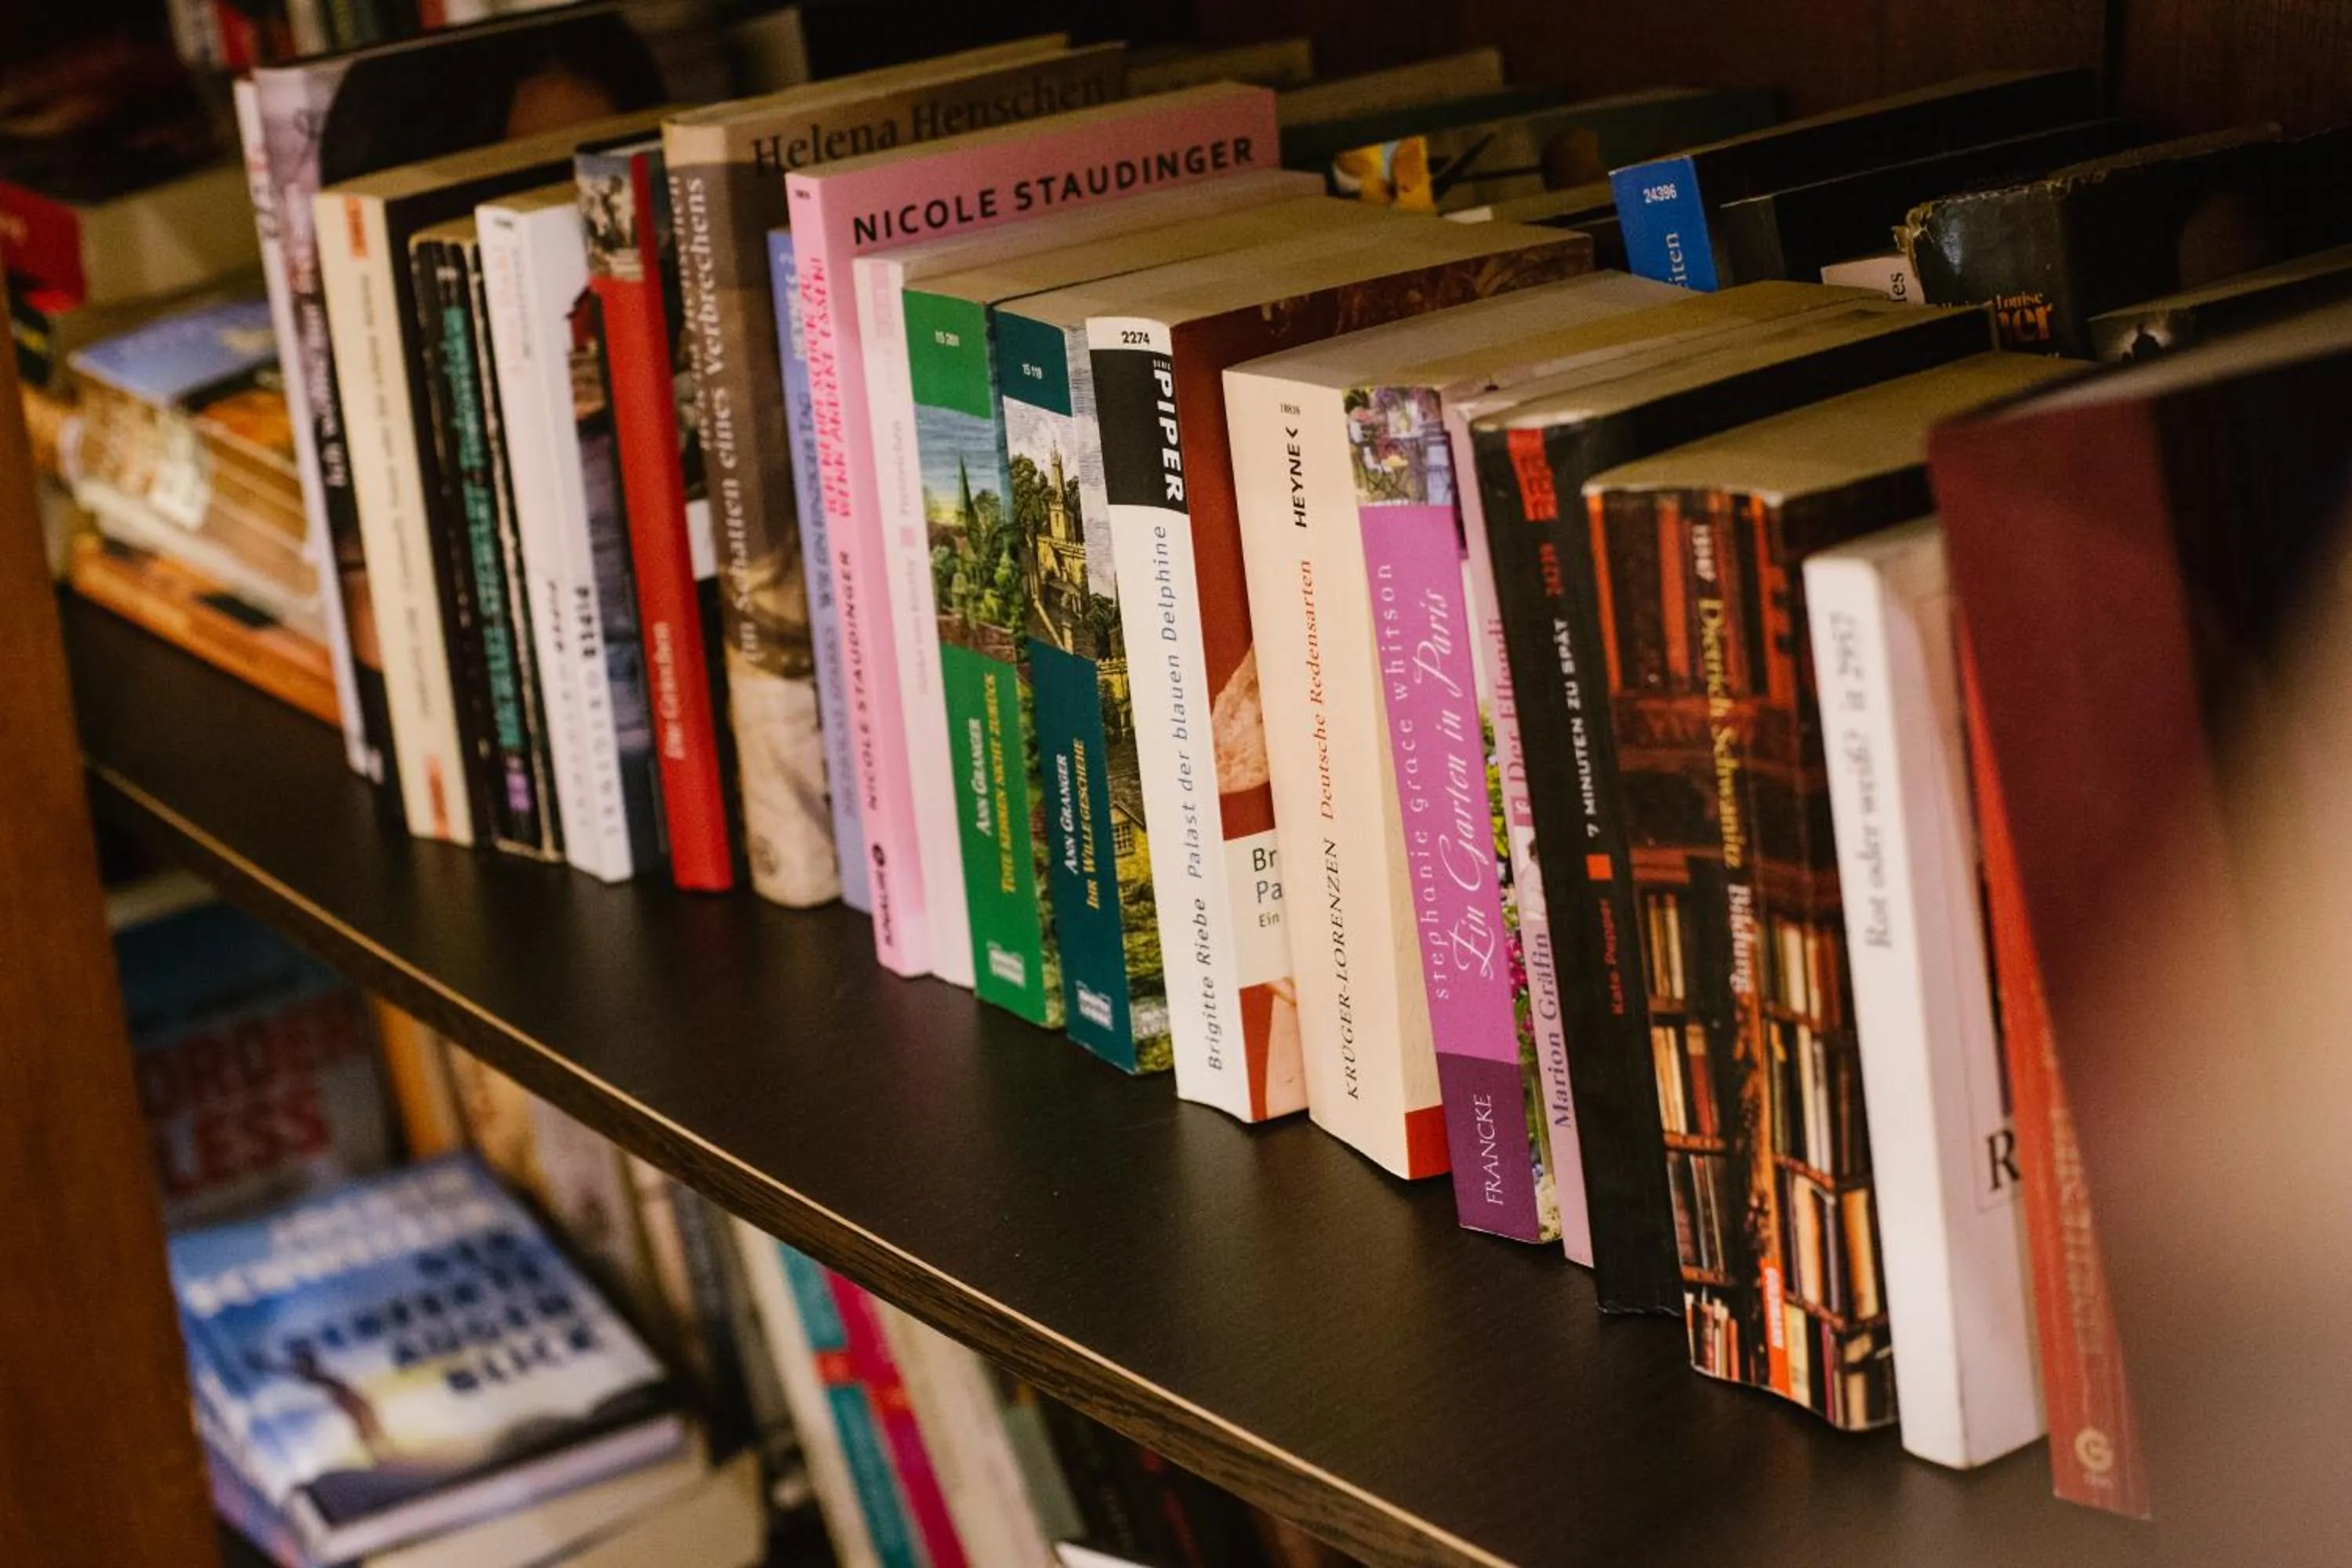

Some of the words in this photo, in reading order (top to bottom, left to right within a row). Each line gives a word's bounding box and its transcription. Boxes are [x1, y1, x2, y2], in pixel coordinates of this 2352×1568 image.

[751, 116, 902, 177] Helena
[853, 189, 998, 245] NICOLE
[1014, 137, 1254, 211] STAUDINGER
[687, 178, 725, 375] Verbrechens
[1121, 330, 1150, 345] 2274
[710, 387, 738, 469] eines
[1153, 368, 1185, 502] PIPER
[1287, 442, 1308, 528] HEYNE
[722, 477, 753, 612] Schatten
[1152, 525, 1180, 642] Delphine
[839, 551, 867, 711] STAUDINGER
[1298, 560, 1326, 706] Redensarten
[1378, 564, 1407, 702] whitson
[1412, 588, 1464, 699] Paris
[1553, 618, 1576, 674] SPÄT
[1698, 598, 1734, 717] Dietrich
[1164, 653, 1188, 742] blauen
[1436, 710, 1462, 742] in
[1565, 681, 1581, 710] ZU
[859, 723, 878, 810] NICOLE
[1057, 754, 1075, 833] GRANGER
[1176, 750, 1194, 792] der
[1309, 713, 1334, 821] Deutsche
[1398, 717, 1428, 813] grace
[1570, 717, 1597, 815] MINUTEN
[1711, 724, 1747, 869] Schwanitz
[1179, 802, 1203, 880] Palast
[1439, 753, 1490, 893] Garten
[1587, 823, 1600, 837] 7
[1193, 897, 1212, 967] Riebe
[1259, 913, 1279, 928] Ein
[1411, 830, 1450, 1000] stephanie
[1451, 905, 1494, 979] Ein
[1727, 884, 1755, 993] Bildung
[1201, 975, 1224, 1072] Brigitte
[1528, 932, 1558, 1021] Gräfin
[1609, 971, 1624, 1015] Kate
[1546, 1030, 1573, 1128] Marion
[1477, 1093, 1504, 1205] FRANCKE
